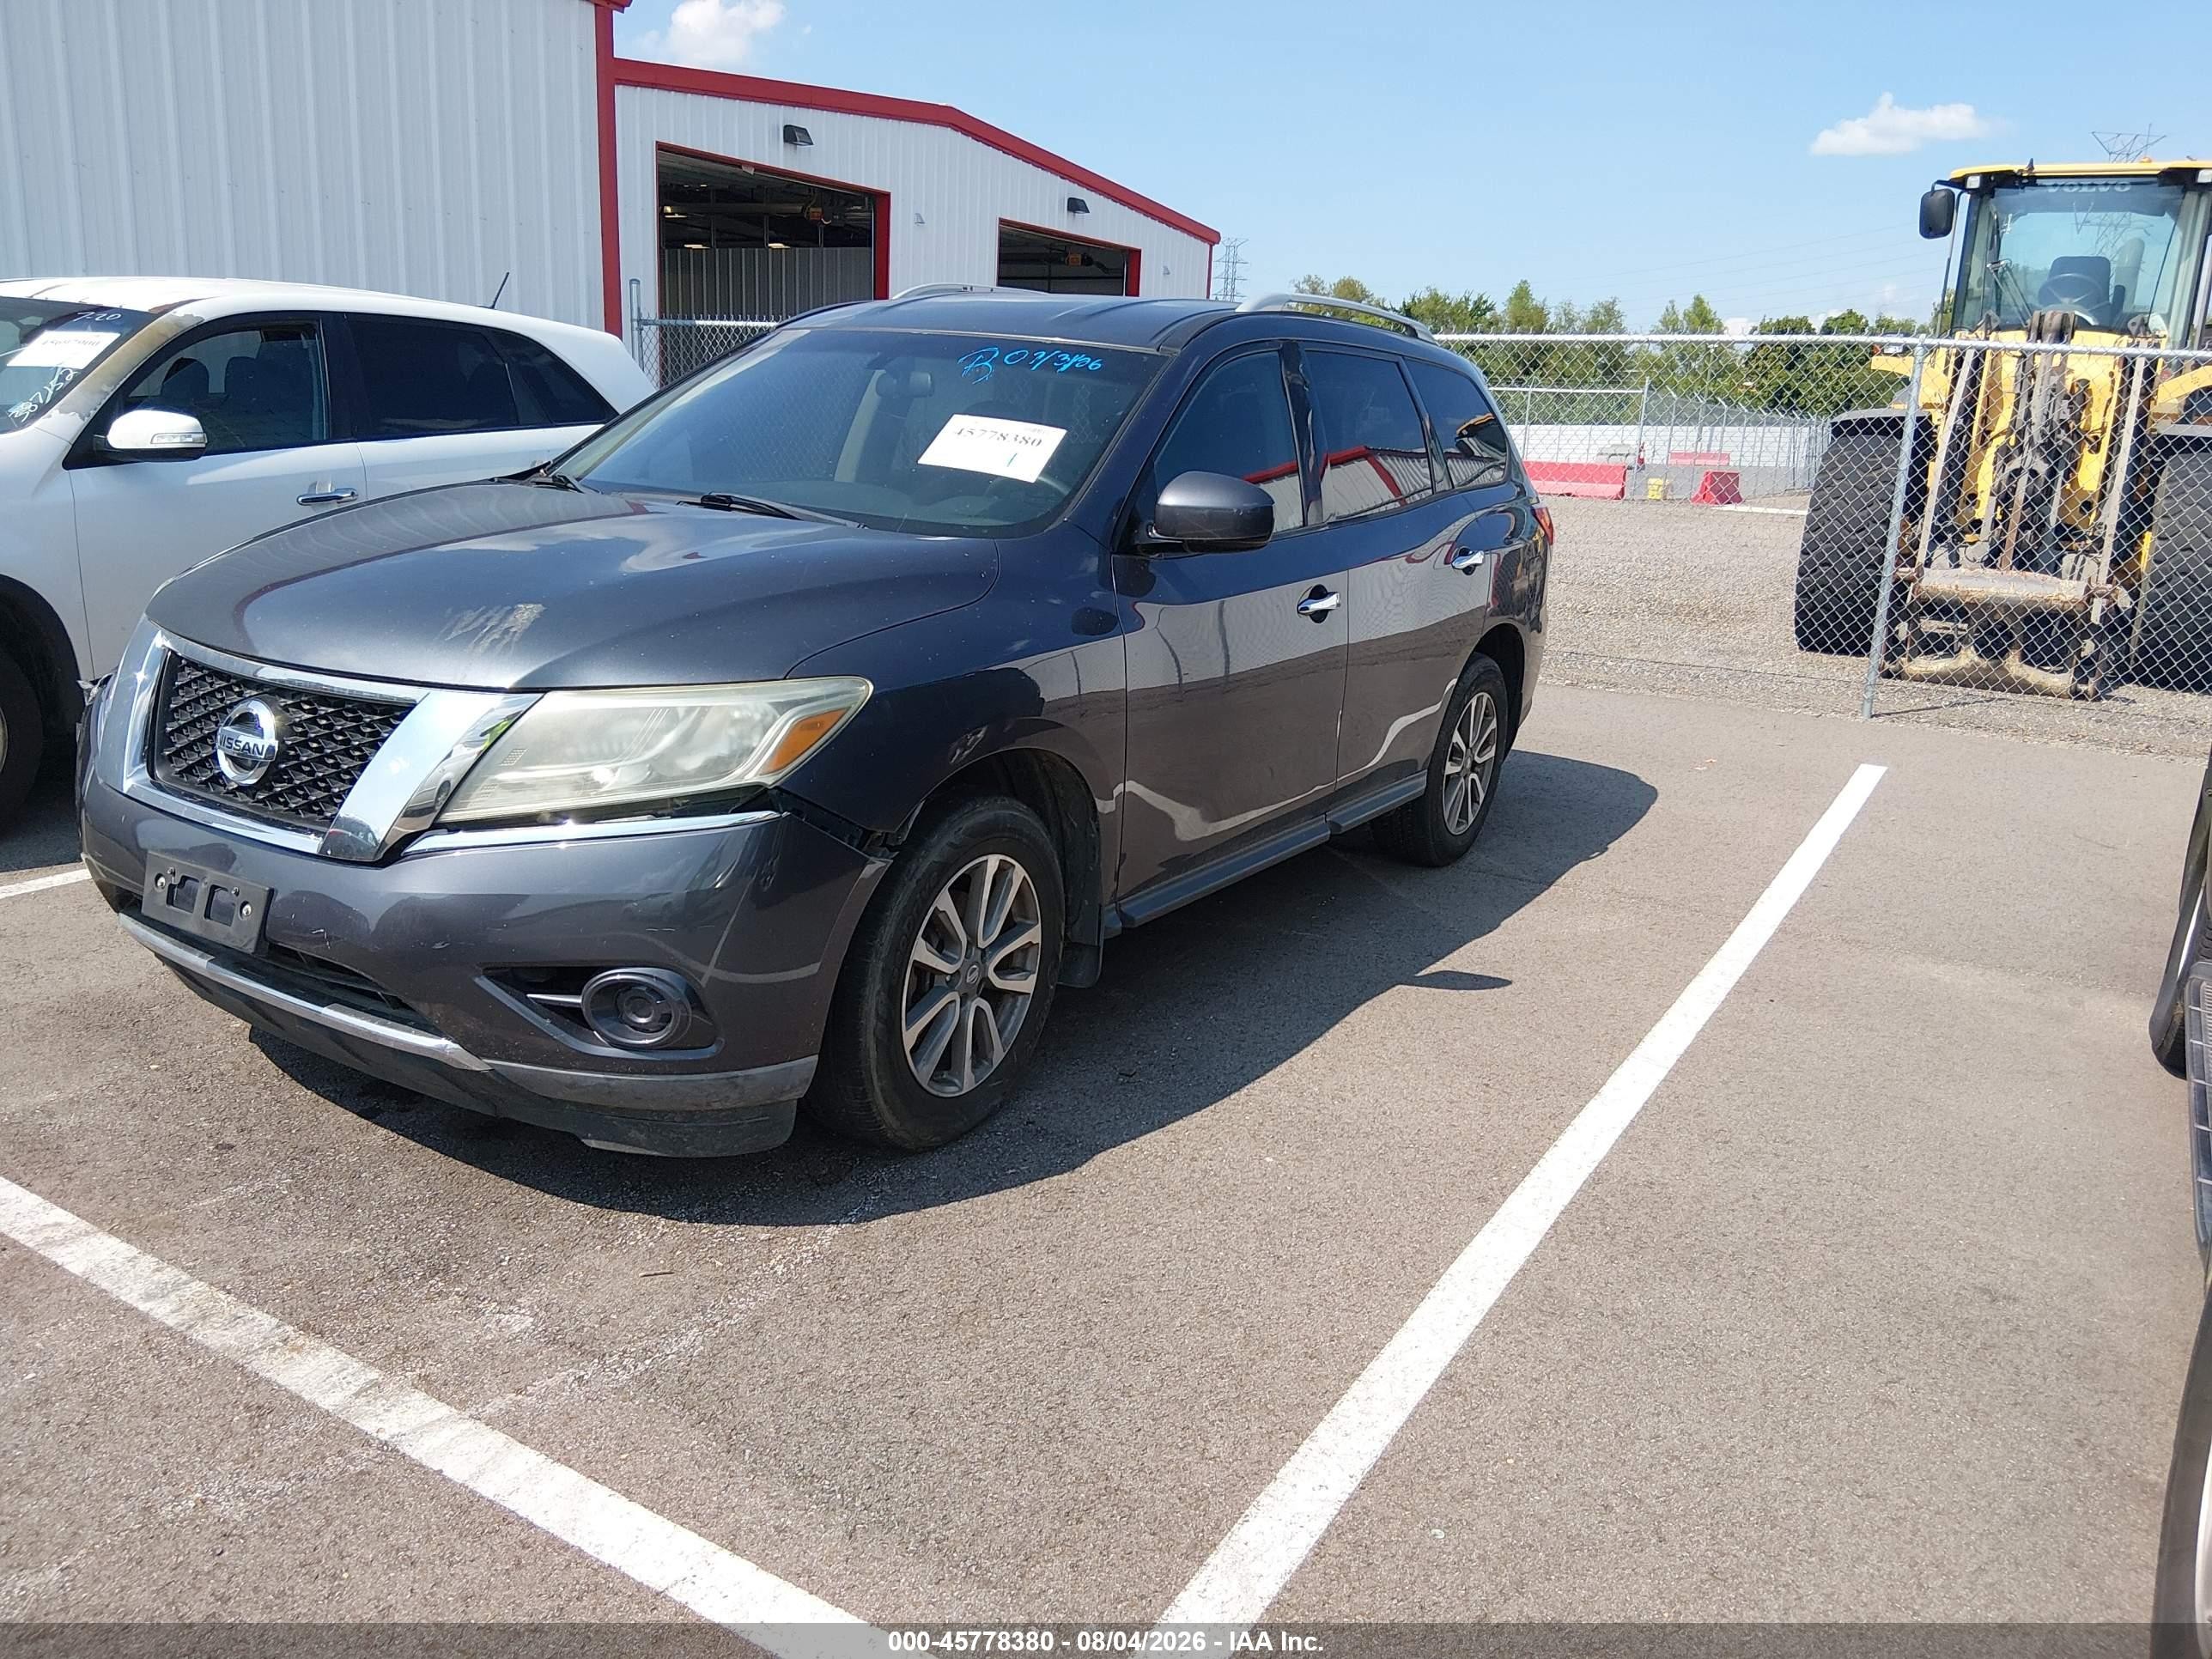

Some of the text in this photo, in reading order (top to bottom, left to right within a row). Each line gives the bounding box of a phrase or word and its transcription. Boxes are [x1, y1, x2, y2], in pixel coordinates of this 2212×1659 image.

[2045, 181, 2131, 192] VOLVO
[73, 311, 122, 322] 7-20
[219, 734, 264, 757] NISSAN
